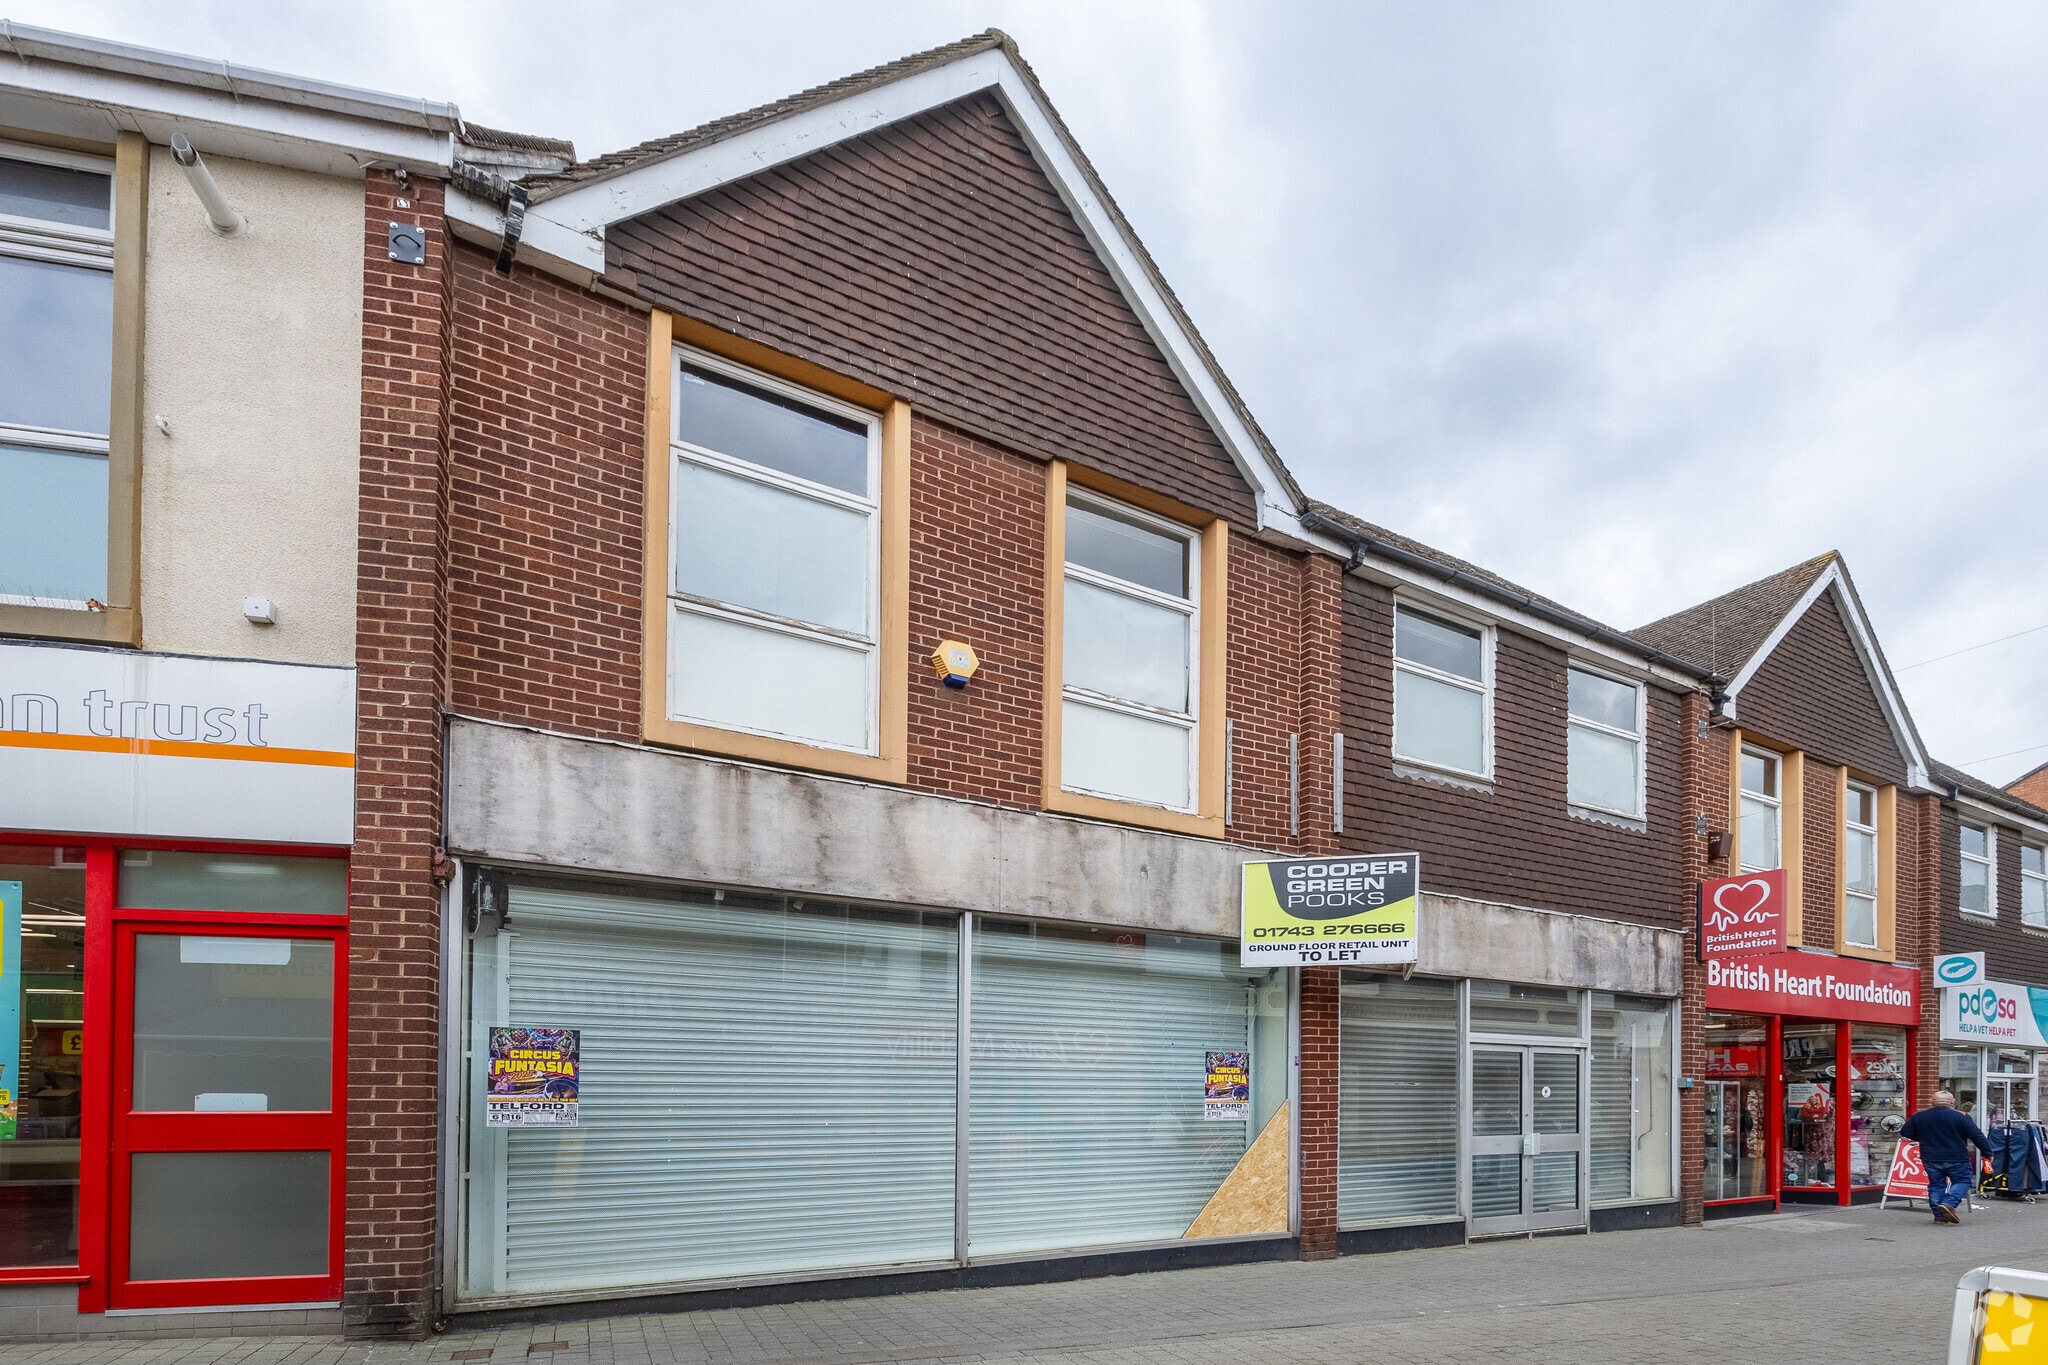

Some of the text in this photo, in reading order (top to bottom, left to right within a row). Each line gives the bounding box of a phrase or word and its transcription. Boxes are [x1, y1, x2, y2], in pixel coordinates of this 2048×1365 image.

[0, 689, 269, 747] n trust
[1287, 861, 1407, 878] COOPER
[1287, 877, 1384, 892] GREEN
[1288, 892, 1384, 908] POOKS
[1254, 923, 1405, 937] 01743 276666
[1706, 928, 1776, 943] British Heart
[1249, 943, 1296, 952] GROUND
[1299, 942, 1335, 950] FLOOR
[1706, 938, 1777, 953] Foundation
[1299, 950, 1361, 962] TO LET
[1708, 960, 1911, 1007] British Heart Foundation
[1959, 988, 2016, 1023] pdsa
[1959, 1024, 1973, 1033] HELP
[1978, 1025, 1988, 1034] VET
[1989, 1027, 2002, 1036] HELP
[2007, 1028, 2016, 1037] PET
[510, 1050, 560, 1060] CIRCUS
[495, 1060, 575, 1077] FUNTASIA
[1208, 1075, 1247, 1084] FUNTASIA
